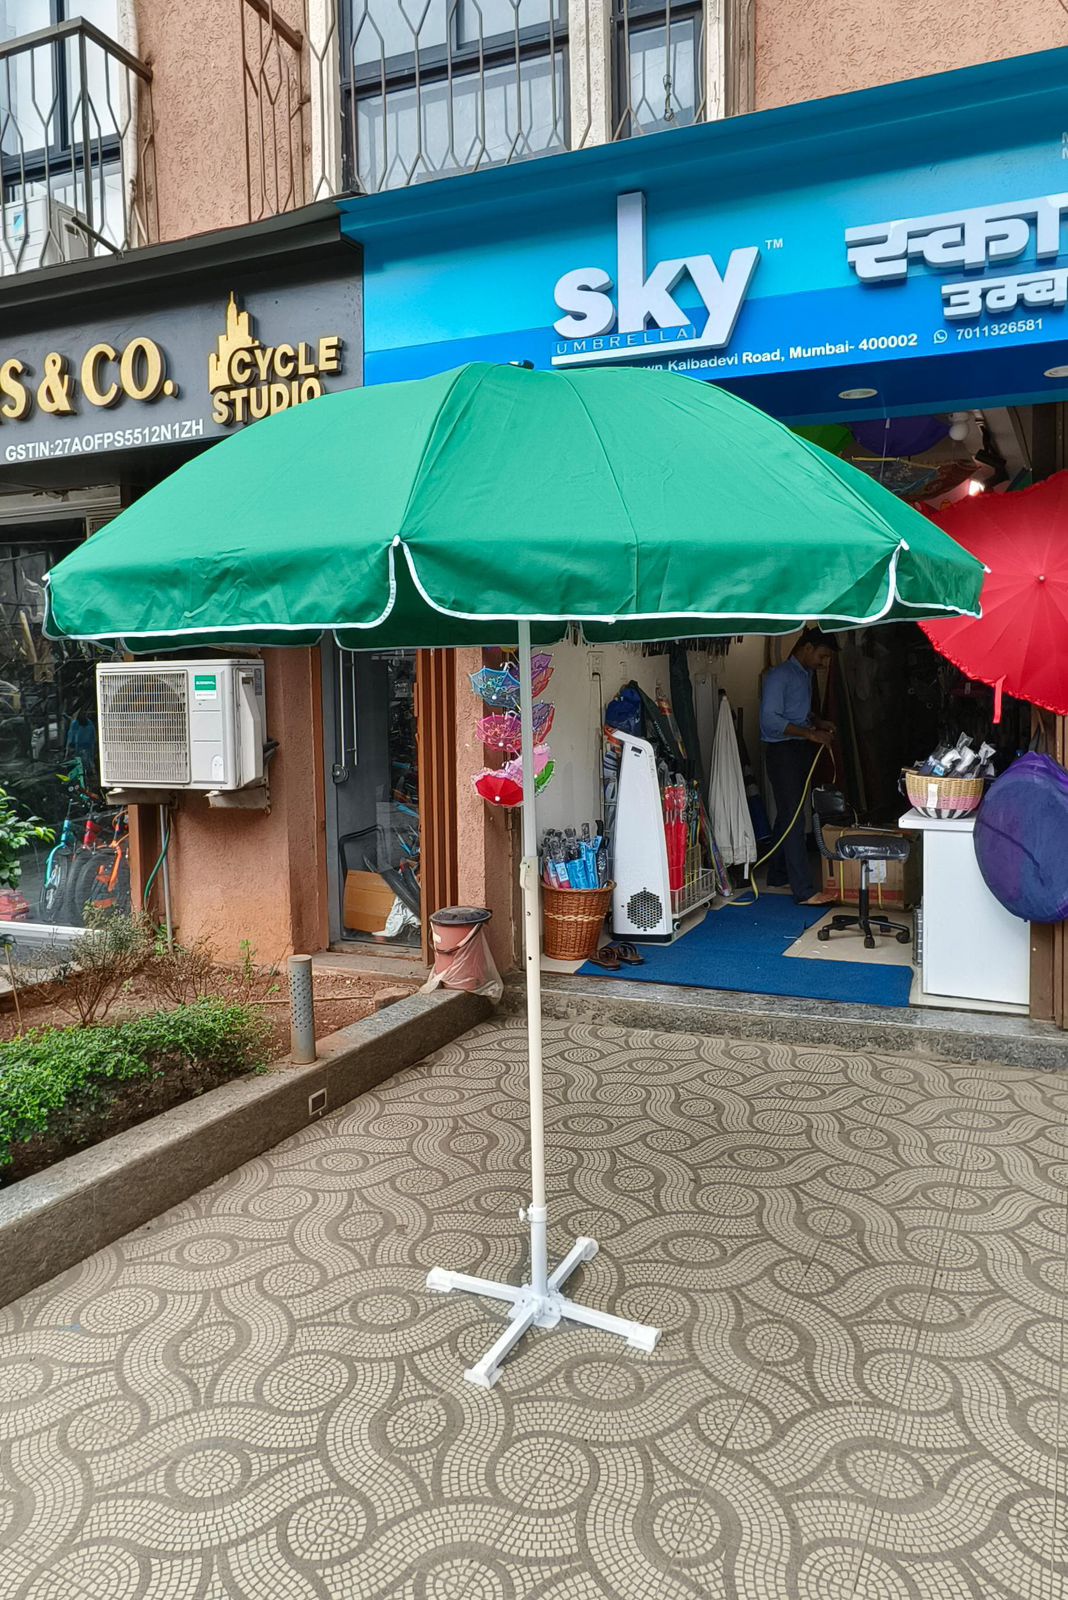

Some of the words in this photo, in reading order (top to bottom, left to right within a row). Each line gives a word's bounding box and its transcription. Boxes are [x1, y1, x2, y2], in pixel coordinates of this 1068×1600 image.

[553, 191, 760, 346] sky
[228, 336, 342, 384] CYCLE
[556, 327, 688, 355] UMBRELLA
[742, 348, 785, 365] Road,
[858, 333, 918, 351] 400002
[956, 318, 1043, 340] 7011326581
[212, 377, 324, 425] STUDIO
[5, 418, 205, 461] GSTIN:27AOFPS5512N1ZH
